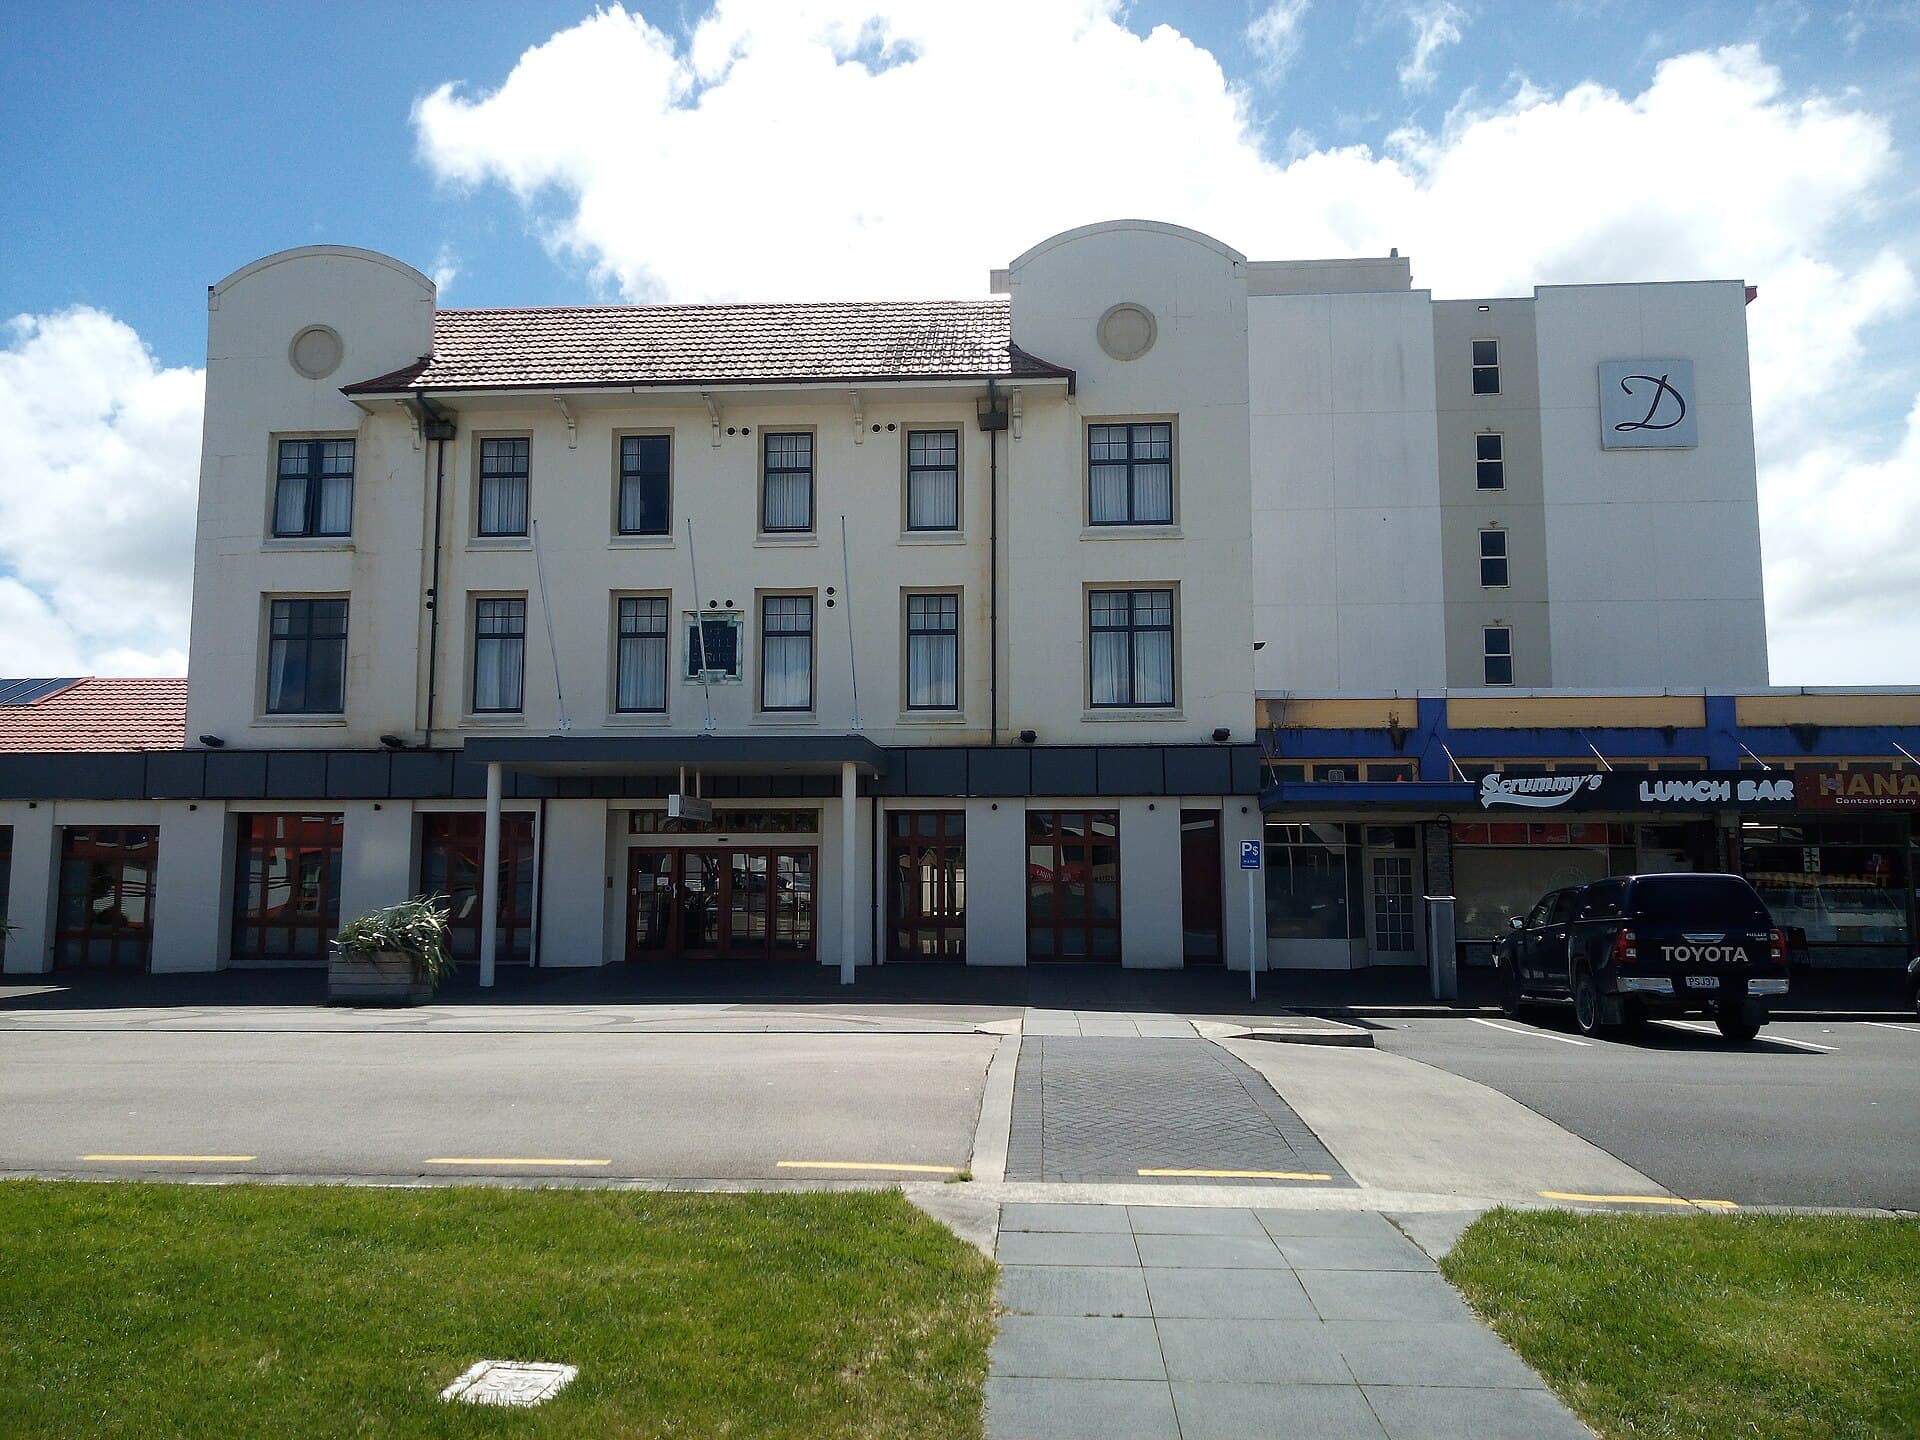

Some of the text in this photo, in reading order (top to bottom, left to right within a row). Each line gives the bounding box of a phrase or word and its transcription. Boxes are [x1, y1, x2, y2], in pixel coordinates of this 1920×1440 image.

[1614, 374, 1686, 432] D
[1479, 773, 1604, 808] Scrummy's
[1639, 780, 1795, 802] LUNCH BAR
[1819, 773, 1920, 796] HANA
[1835, 797, 1917, 806] Contemporary
[1660, 946, 1749, 962] TOYOTA
